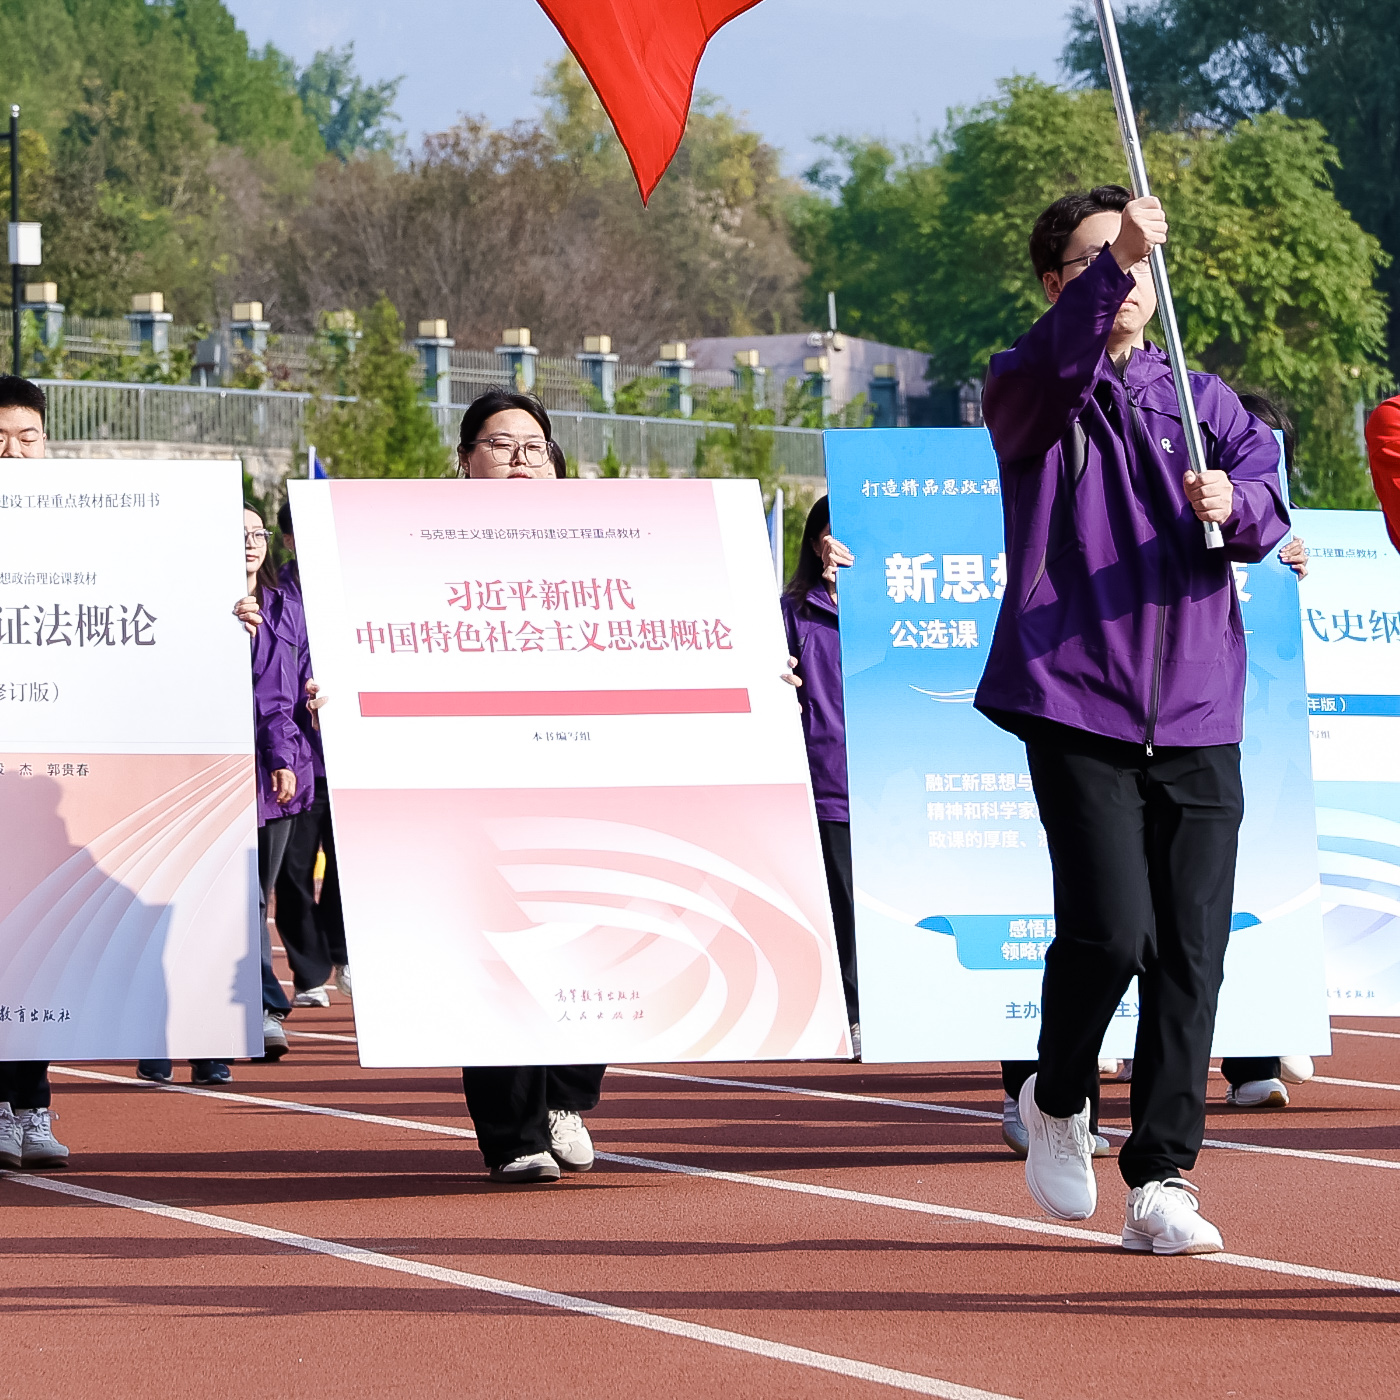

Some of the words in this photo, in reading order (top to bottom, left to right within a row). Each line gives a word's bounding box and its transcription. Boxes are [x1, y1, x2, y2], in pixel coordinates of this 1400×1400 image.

[420, 528, 641, 540] 马克思主义理论研究和建设工程重点教材
[444, 578, 636, 612] 习近平新时代
[355, 618, 734, 654] 中国特色社会主义思想概论
[890, 619, 979, 649] 公选课
[47, 763, 90, 777] 郭贵春
[925, 773, 1033, 792] 融汇新思想与
[927, 802, 1039, 821] 精神和科学家
